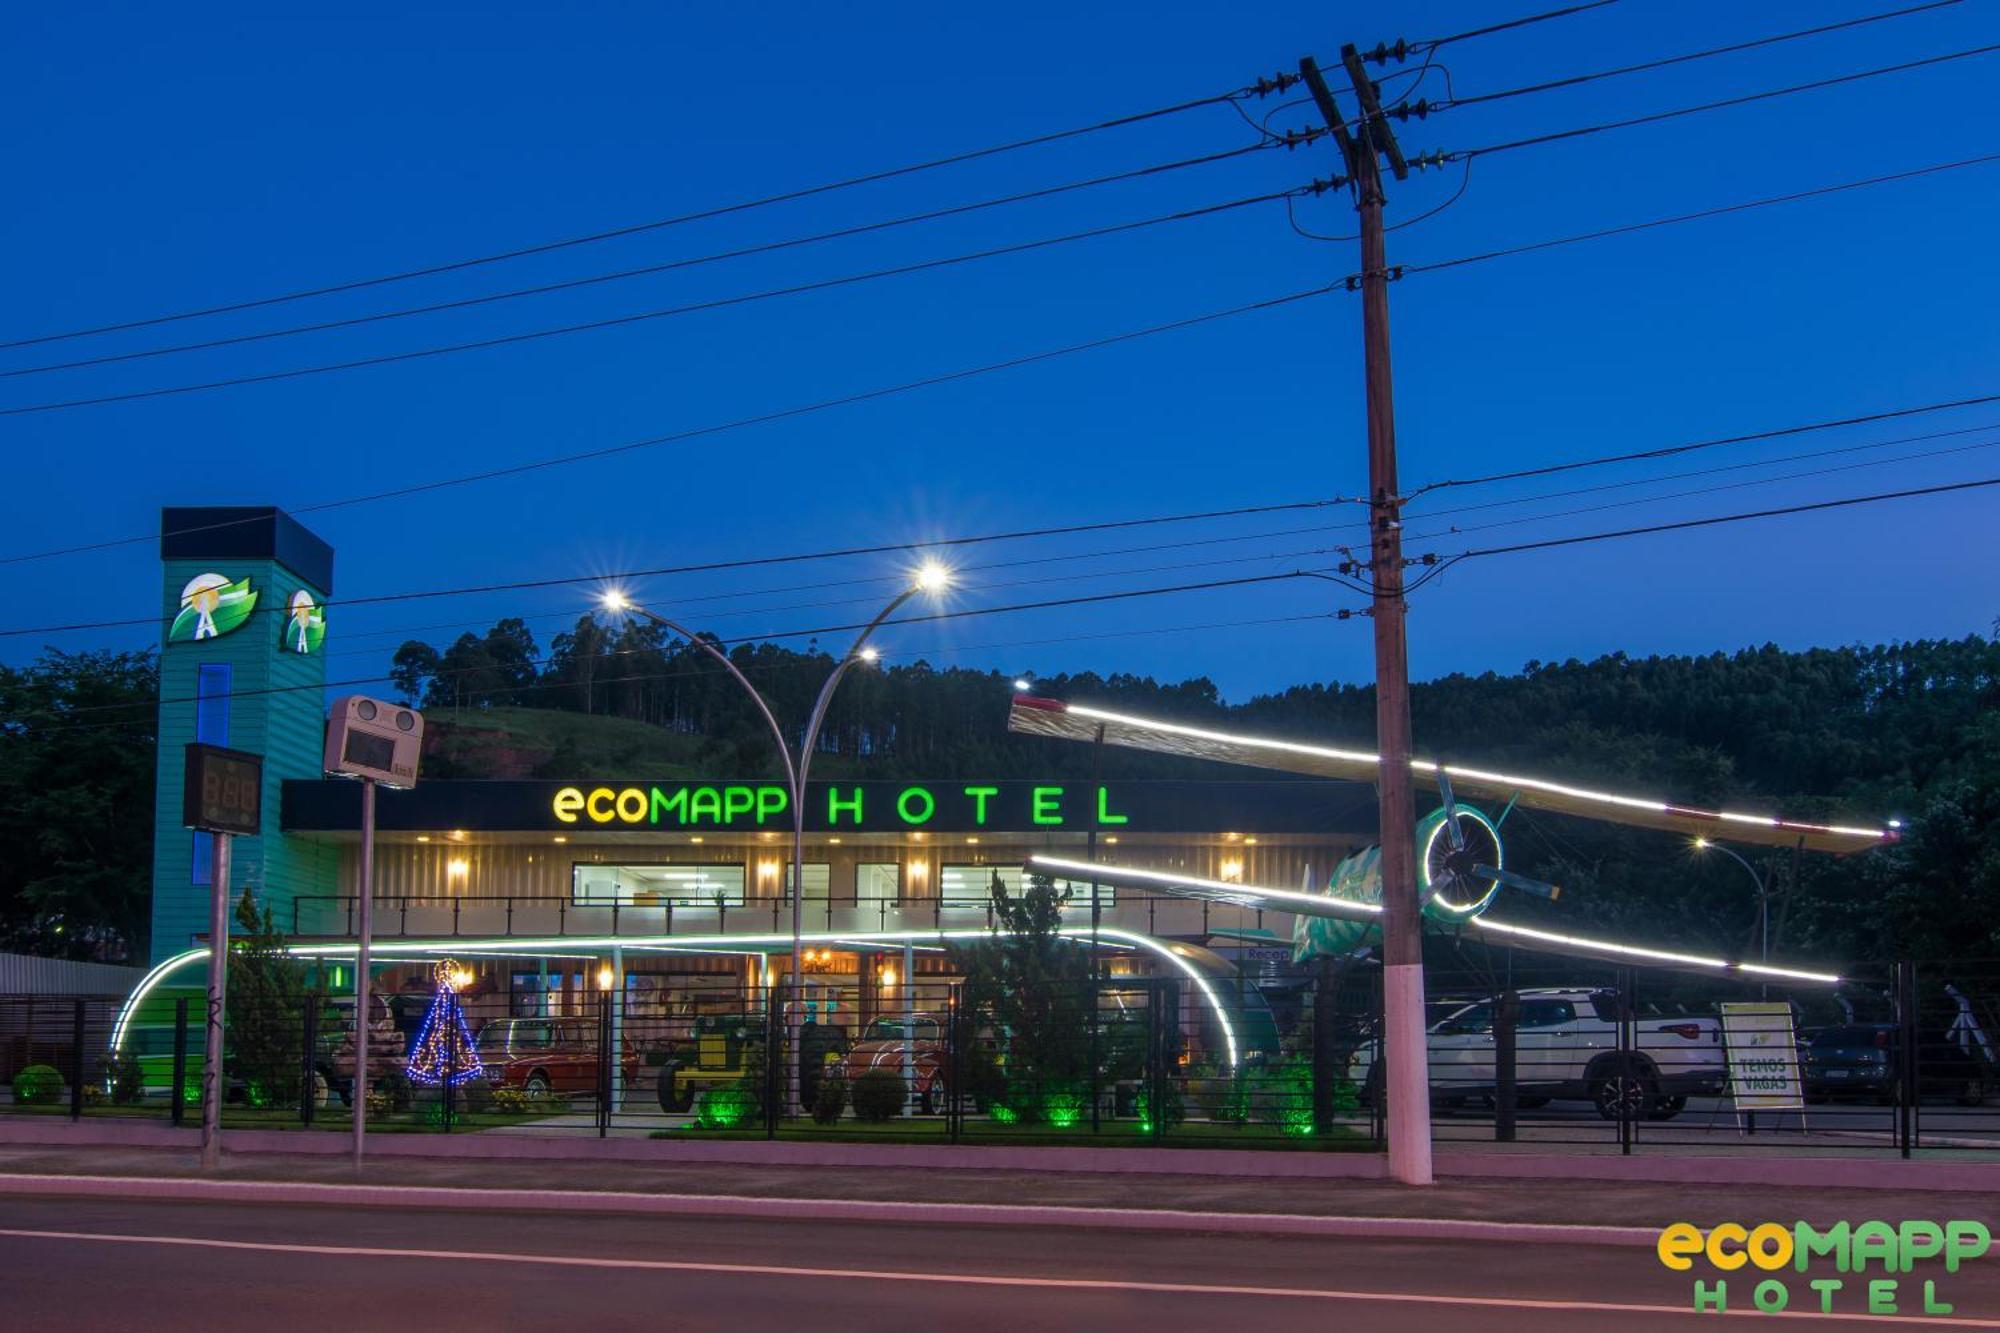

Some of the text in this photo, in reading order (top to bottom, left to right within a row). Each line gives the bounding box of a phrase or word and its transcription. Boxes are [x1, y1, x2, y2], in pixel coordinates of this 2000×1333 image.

[552, 786, 1129, 825] ecoMAPP HOTEL
[1741, 1057, 1787, 1073] TEMOS
[1744, 1075, 1788, 1090] VAGAS
